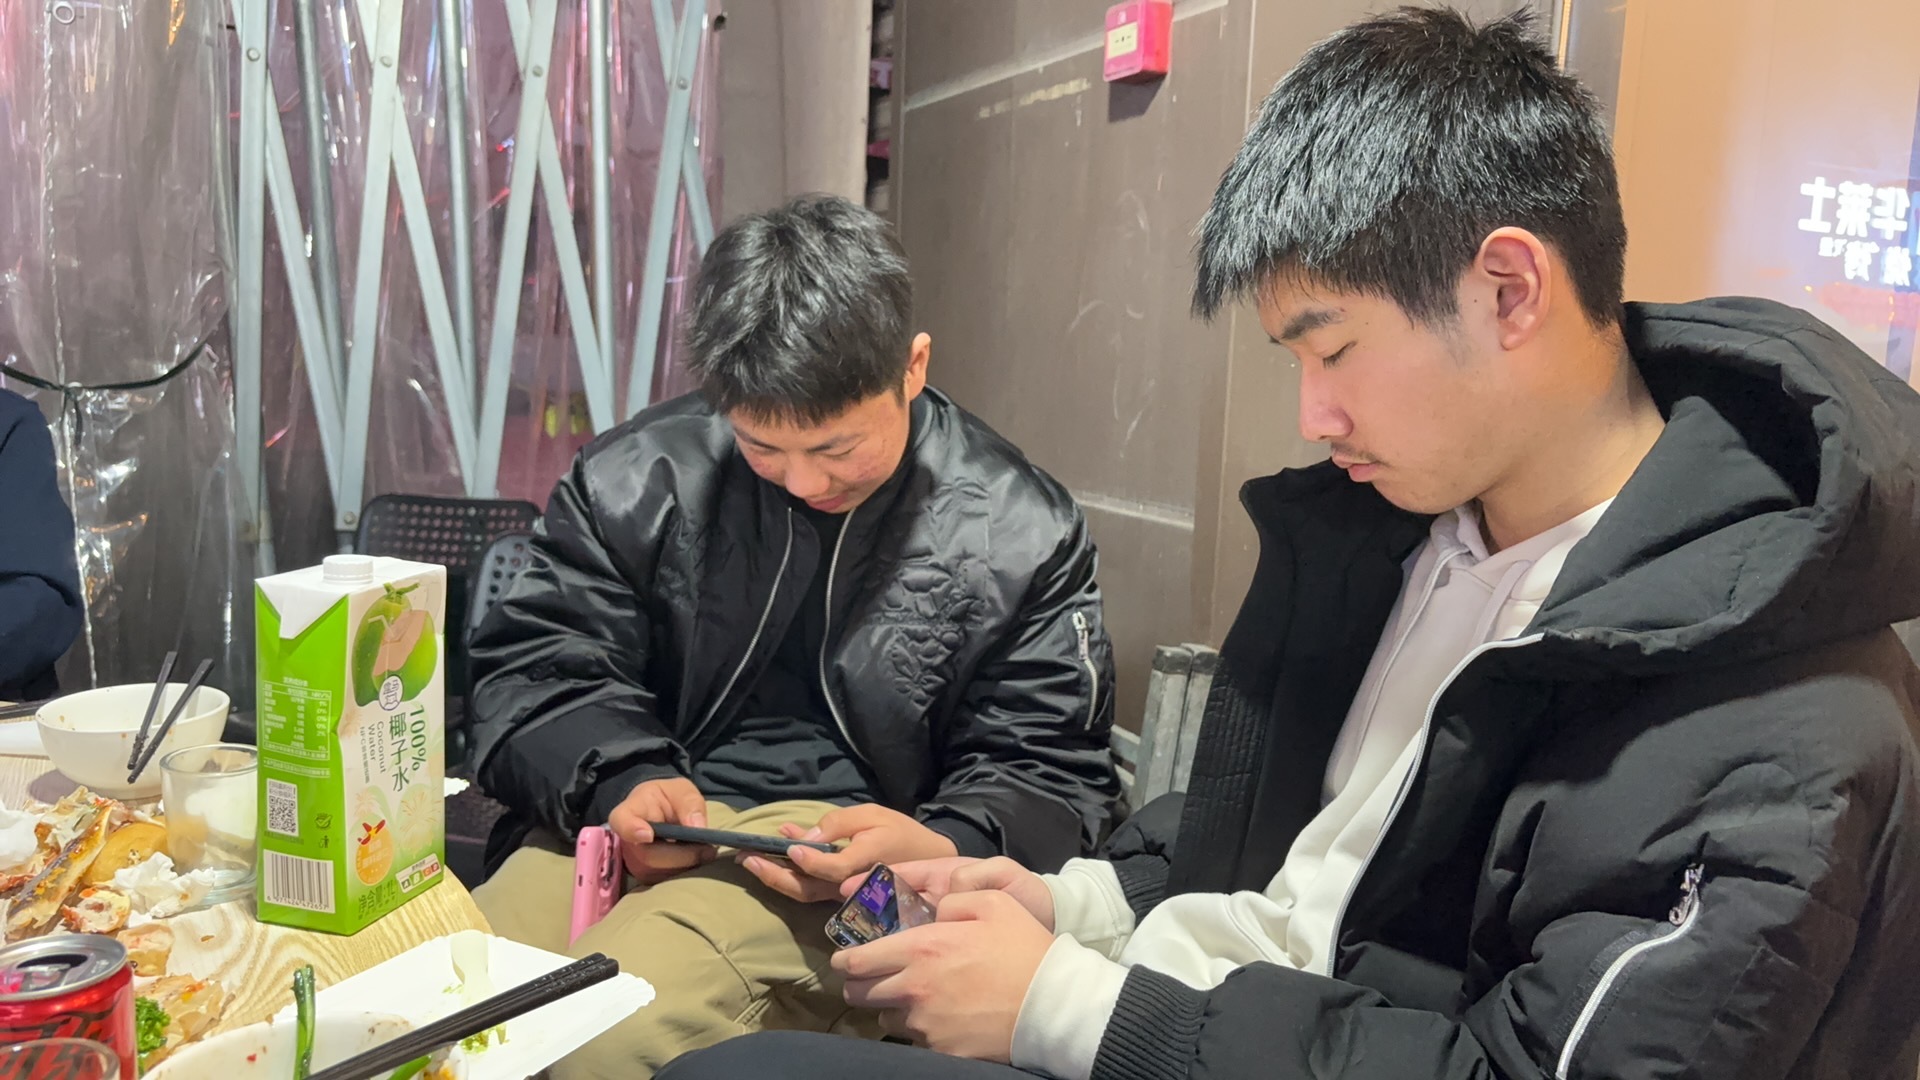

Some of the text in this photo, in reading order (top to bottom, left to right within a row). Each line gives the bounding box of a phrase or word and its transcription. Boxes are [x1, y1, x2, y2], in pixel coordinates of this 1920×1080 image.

[367, 723, 377, 761] Water
[376, 721, 387, 773] Coconut
[388, 711, 410, 792] 椰子水
[410, 704, 427, 771] 100%
[302, 901, 328, 910] 472657
